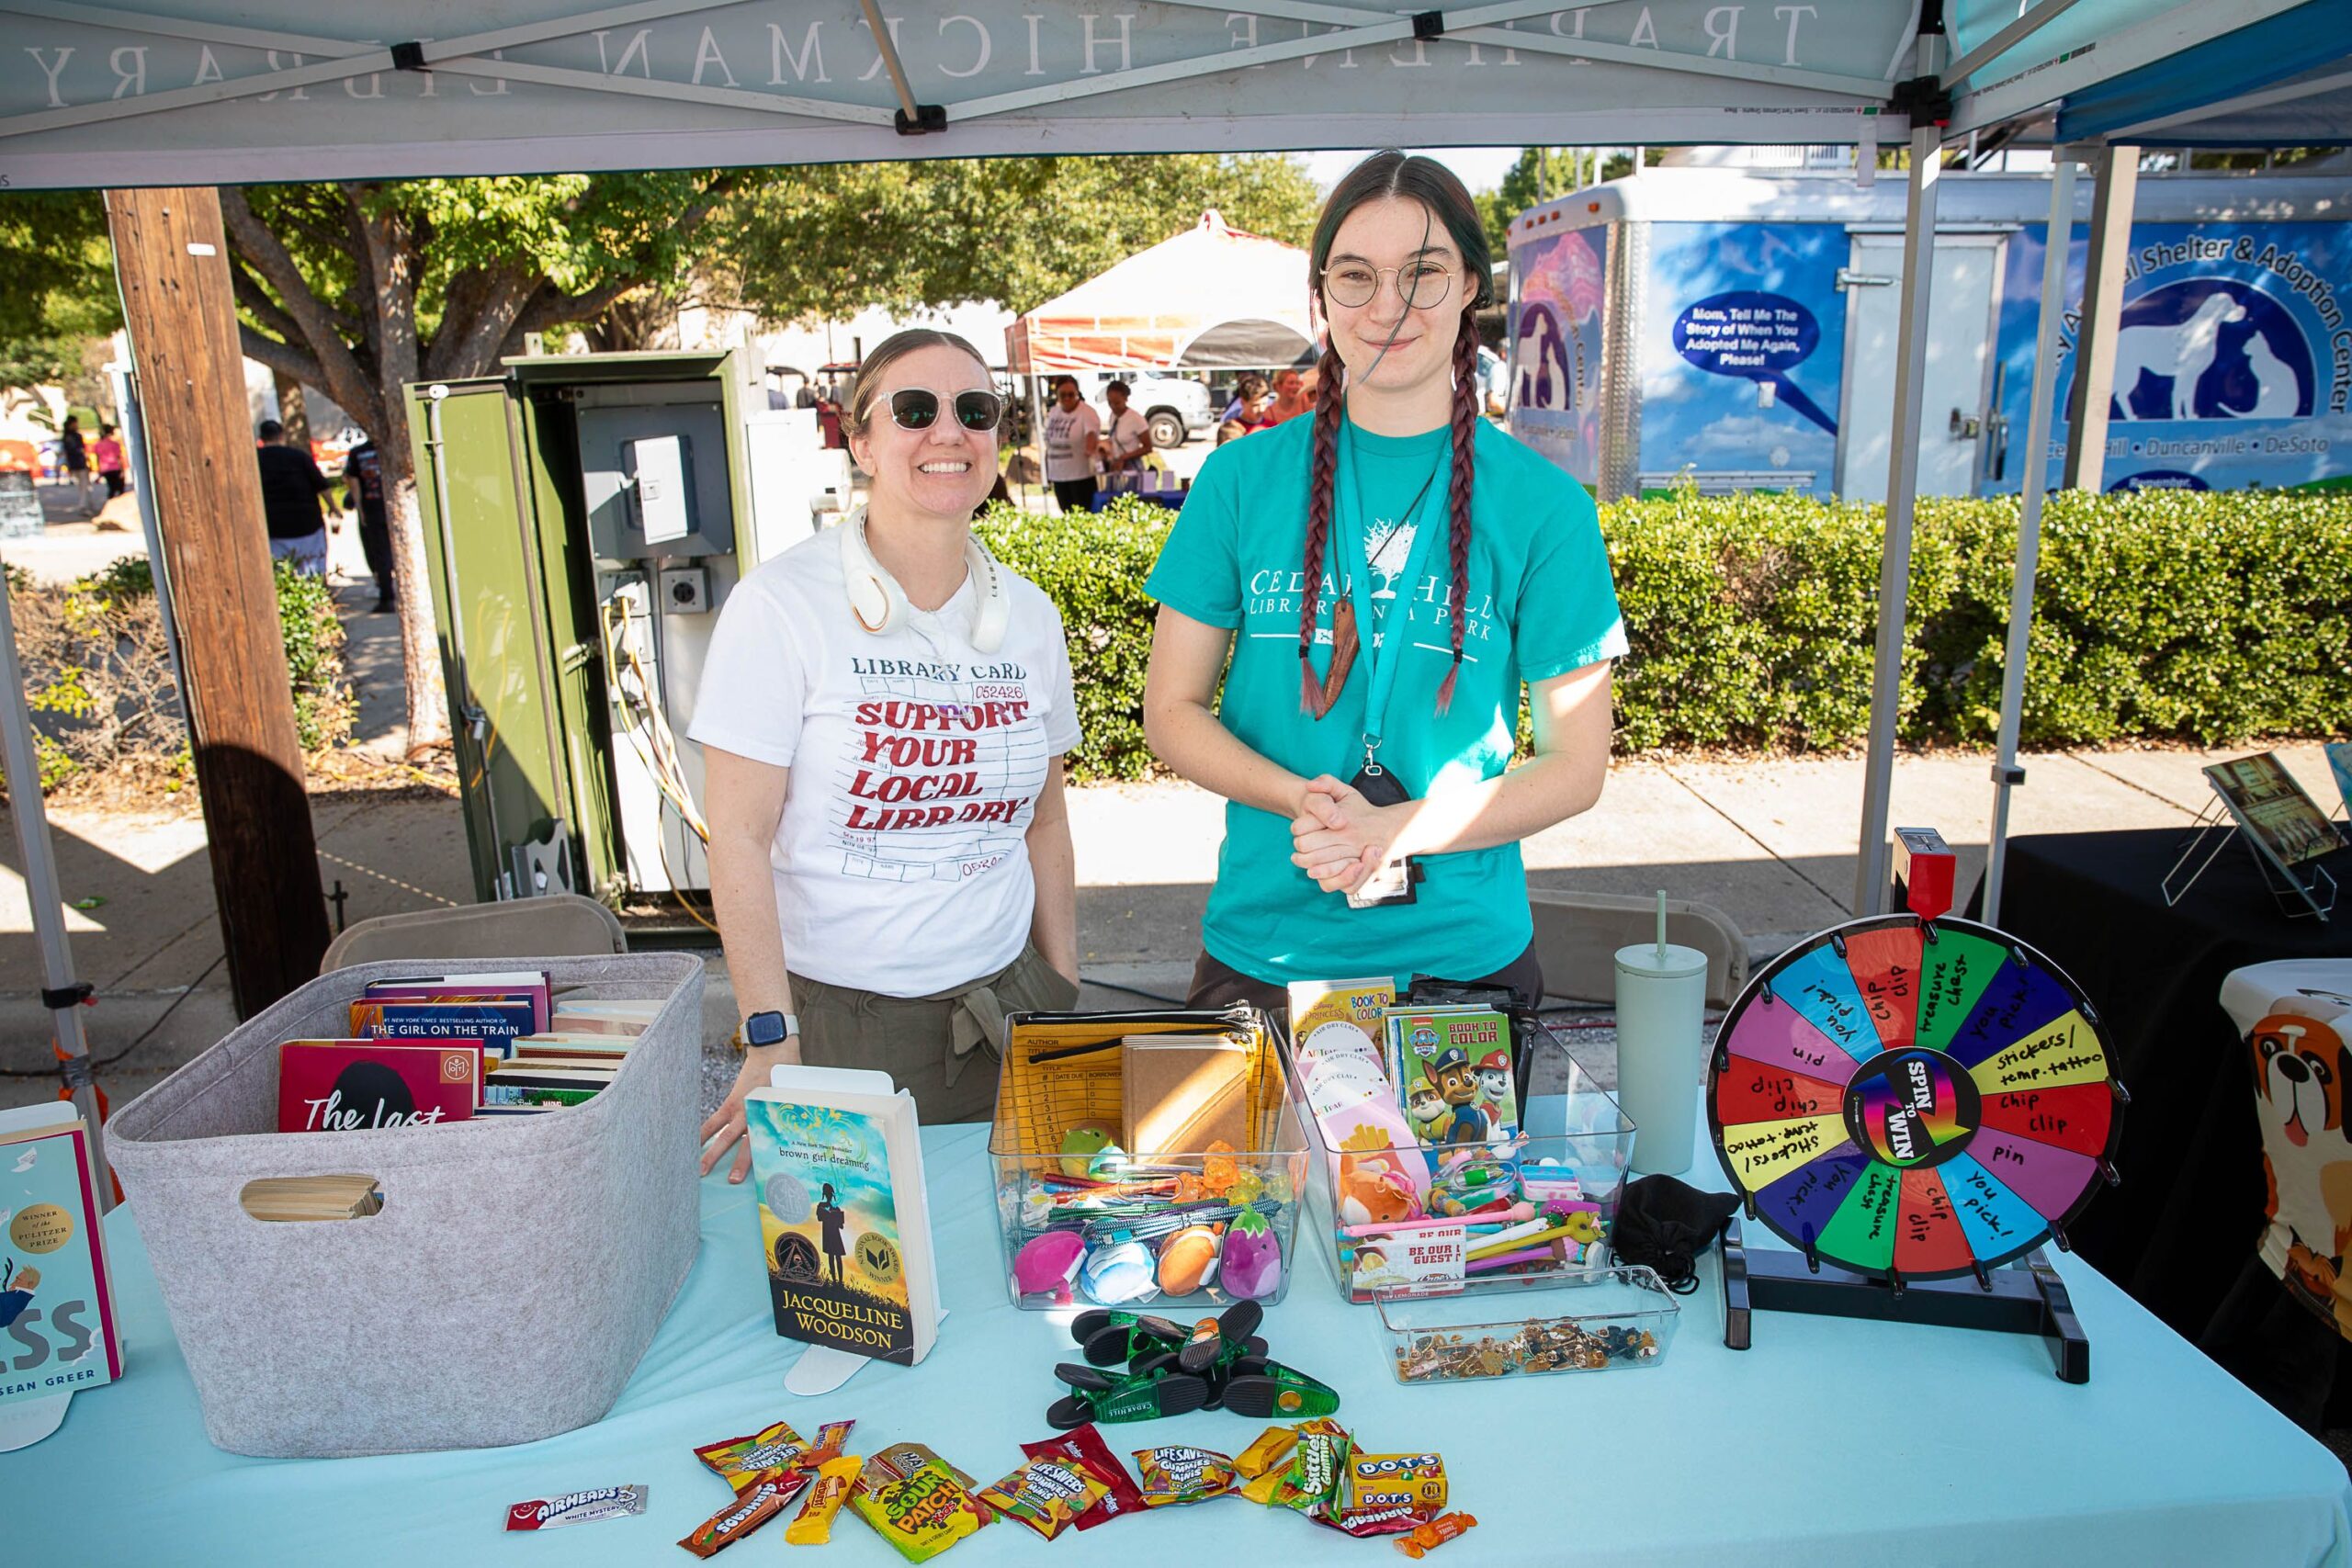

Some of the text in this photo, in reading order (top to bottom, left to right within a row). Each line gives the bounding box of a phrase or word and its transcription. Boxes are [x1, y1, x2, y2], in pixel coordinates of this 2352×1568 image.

[1692, 308, 1798, 321] Mom, Tell Me The
[2143, 235, 2352, 414] Shelter & Adoption Center
[1685, 322, 1799, 337] Story of When You
[1685, 338, 1801, 353] Adopted Me Again,
[1719, 354, 1765, 366] Please!
[2146, 439, 2246, 457] Duncanville
[2265, 436, 2330, 455] DeSoto
[1250, 598, 1491, 640] LIBRR PRK
[852, 657, 1027, 682] LIBRARY CARD
[976, 686, 1023, 699] 052426
[855, 701, 1030, 731] SUPPORT
[861, 731, 978, 767] YOUR
[848, 770, 984, 803] LOCAL
[845, 796, 1030, 831] LIBRARY
[1888, 964, 1908, 998] clip
[1944, 953, 1968, 1006] chest
[1351, 993, 1389, 1009] BOOK TO
[1868, 981, 1892, 1021] chip
[1917, 961, 1948, 1033] treasure
[1357, 1008, 1383, 1021] COLOR
[371, 1024, 519, 1035] THE GIRL ON THE TRAIN
[1448, 1021, 1498, 1032] BOOK TO
[1408, 1032, 1441, 1046] PAW
[1450, 1031, 1498, 1044] COLOR
[1792, 1046, 1826, 1066] pin
[1751, 1076, 1793, 1096] clip
[1907, 1061, 1932, 1109] SPIN
[304, 1089, 366, 1131] The
[1774, 1095, 1818, 1116] chip
[1905, 1101, 1917, 1118] TO
[2001, 1093, 2040, 1110] chip
[1888, 1110, 1915, 1158] WIN
[2030, 1117, 2068, 1134] clip
[779, 1146, 870, 1171] brown girl dreaming
[1993, 1145, 2025, 1166] pin
[1860, 1173, 1883, 1210] chest
[1868, 1174, 1897, 1240] treasure
[1927, 1187, 1953, 1221] chip
[22, 1211, 57, 1221] WINNER
[18, 1227, 67, 1240] PULITZER
[1908, 1213, 1931, 1241] clip
[29, 1237, 59, 1247] PRIZE
[1409, 1247, 1424, 1256] BE
[1429, 1245, 1452, 1254] OUR
[1414, 1254, 1453, 1265] GUEST
[869, 1271, 893, 1283] WINNER
[783, 1290, 904, 1330] JACQUELINE
[796, 1311, 893, 1350] WOODSON
[45, 1370, 96, 1387] GREER
[1128, 1403, 1152, 1413] CEDAR
[1159, 1459, 1212, 1472] GUMMIES
[1303, 1434, 1323, 1495] Skittle
[1362, 1455, 1435, 1474] DOTS
[1025, 1472, 1070, 1499] GUMMIES
[1170, 1469, 1202, 1483] MINIS
[886, 1472, 945, 1520] SOUR
[1023, 1491, 1046, 1506] FLAVORS
[1026, 1482, 1054, 1501] MINIS
[1365, 1495, 1411, 1504] DOTS
[537, 1486, 619, 1522] AIRHEADS
[565, 1506, 619, 1520] WHITE MYSTERY
[716, 1482, 778, 1534] AIRHEADS
[896, 1481, 962, 1533] PATCH
[933, 1501, 957, 1523] Kids
